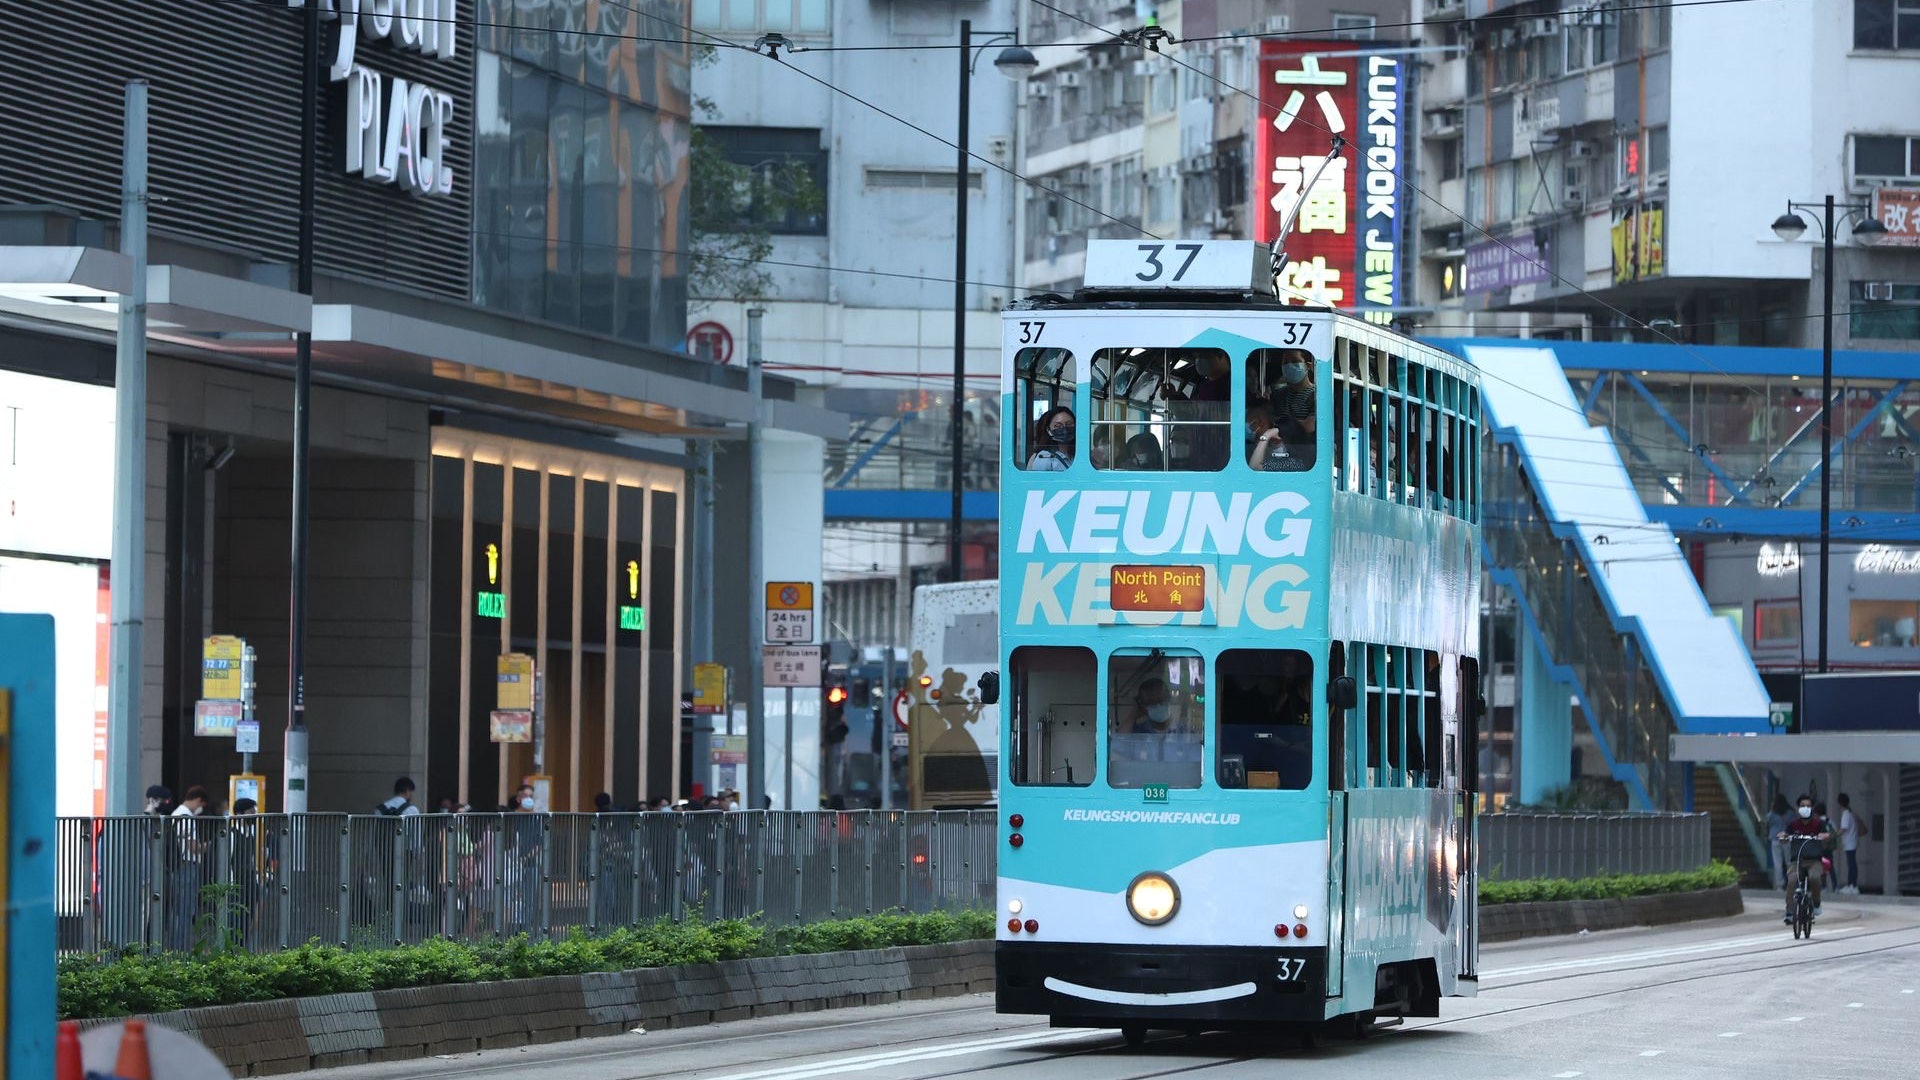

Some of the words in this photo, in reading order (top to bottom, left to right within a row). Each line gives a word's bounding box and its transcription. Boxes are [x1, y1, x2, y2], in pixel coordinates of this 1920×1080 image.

[346, 65, 454, 196] PLACE
[1366, 56, 1397, 219] LUKFOOK
[1135, 244, 1204, 282] 37
[1019, 321, 1046, 344] 37
[1283, 323, 1313, 345] 37
[1016, 490, 1312, 558] KEUNG
[1114, 570, 1157, 586] North
[1163, 570, 1201, 586] Point
[478, 592, 506, 618] ROLEX
[772, 613, 787, 622] 24
[789, 613, 806, 622] hrs
[1145, 788, 1166, 798] 038
[1063, 809, 1241, 825] KEUNGSHOWHKFANCLUB
[1277, 957, 1306, 981] 37
